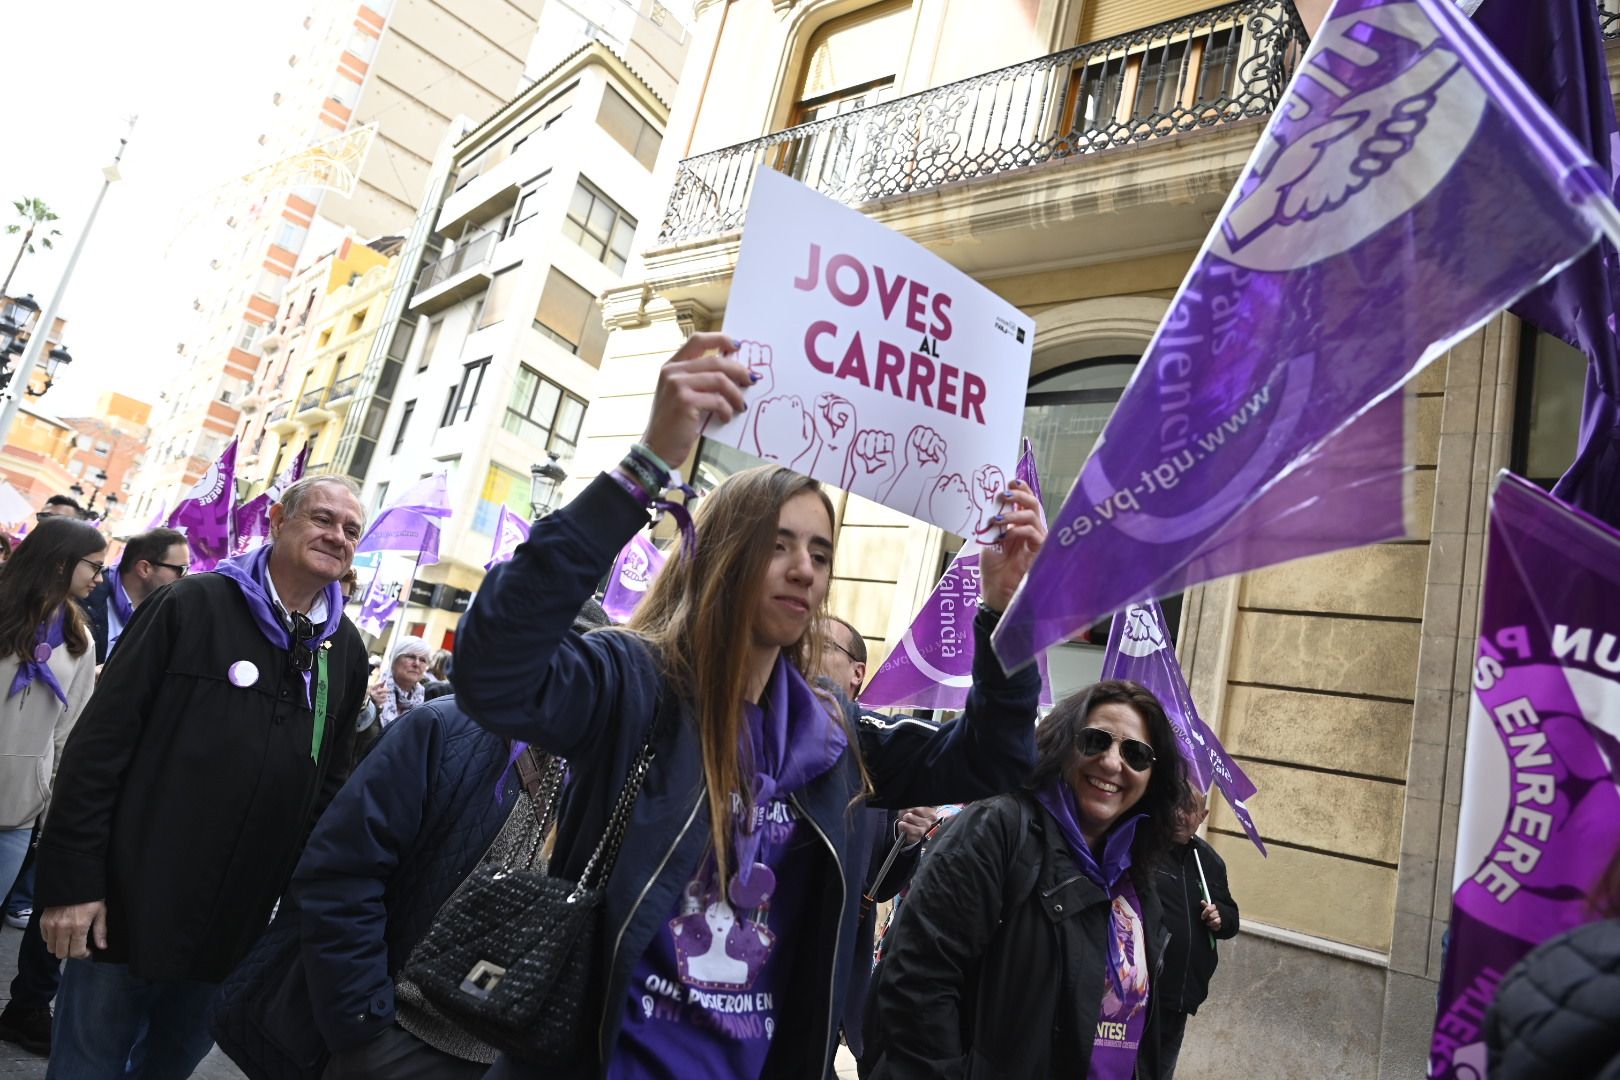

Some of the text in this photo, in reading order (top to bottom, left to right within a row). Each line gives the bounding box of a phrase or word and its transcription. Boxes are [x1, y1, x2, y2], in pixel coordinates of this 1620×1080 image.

[794, 243, 952, 341] JOVES
[804, 320, 986, 425] CARRER
[918, 335, 940, 359] AL
[1474, 696, 1557, 904] ENRERE
[755, 992, 773, 1011] EN
